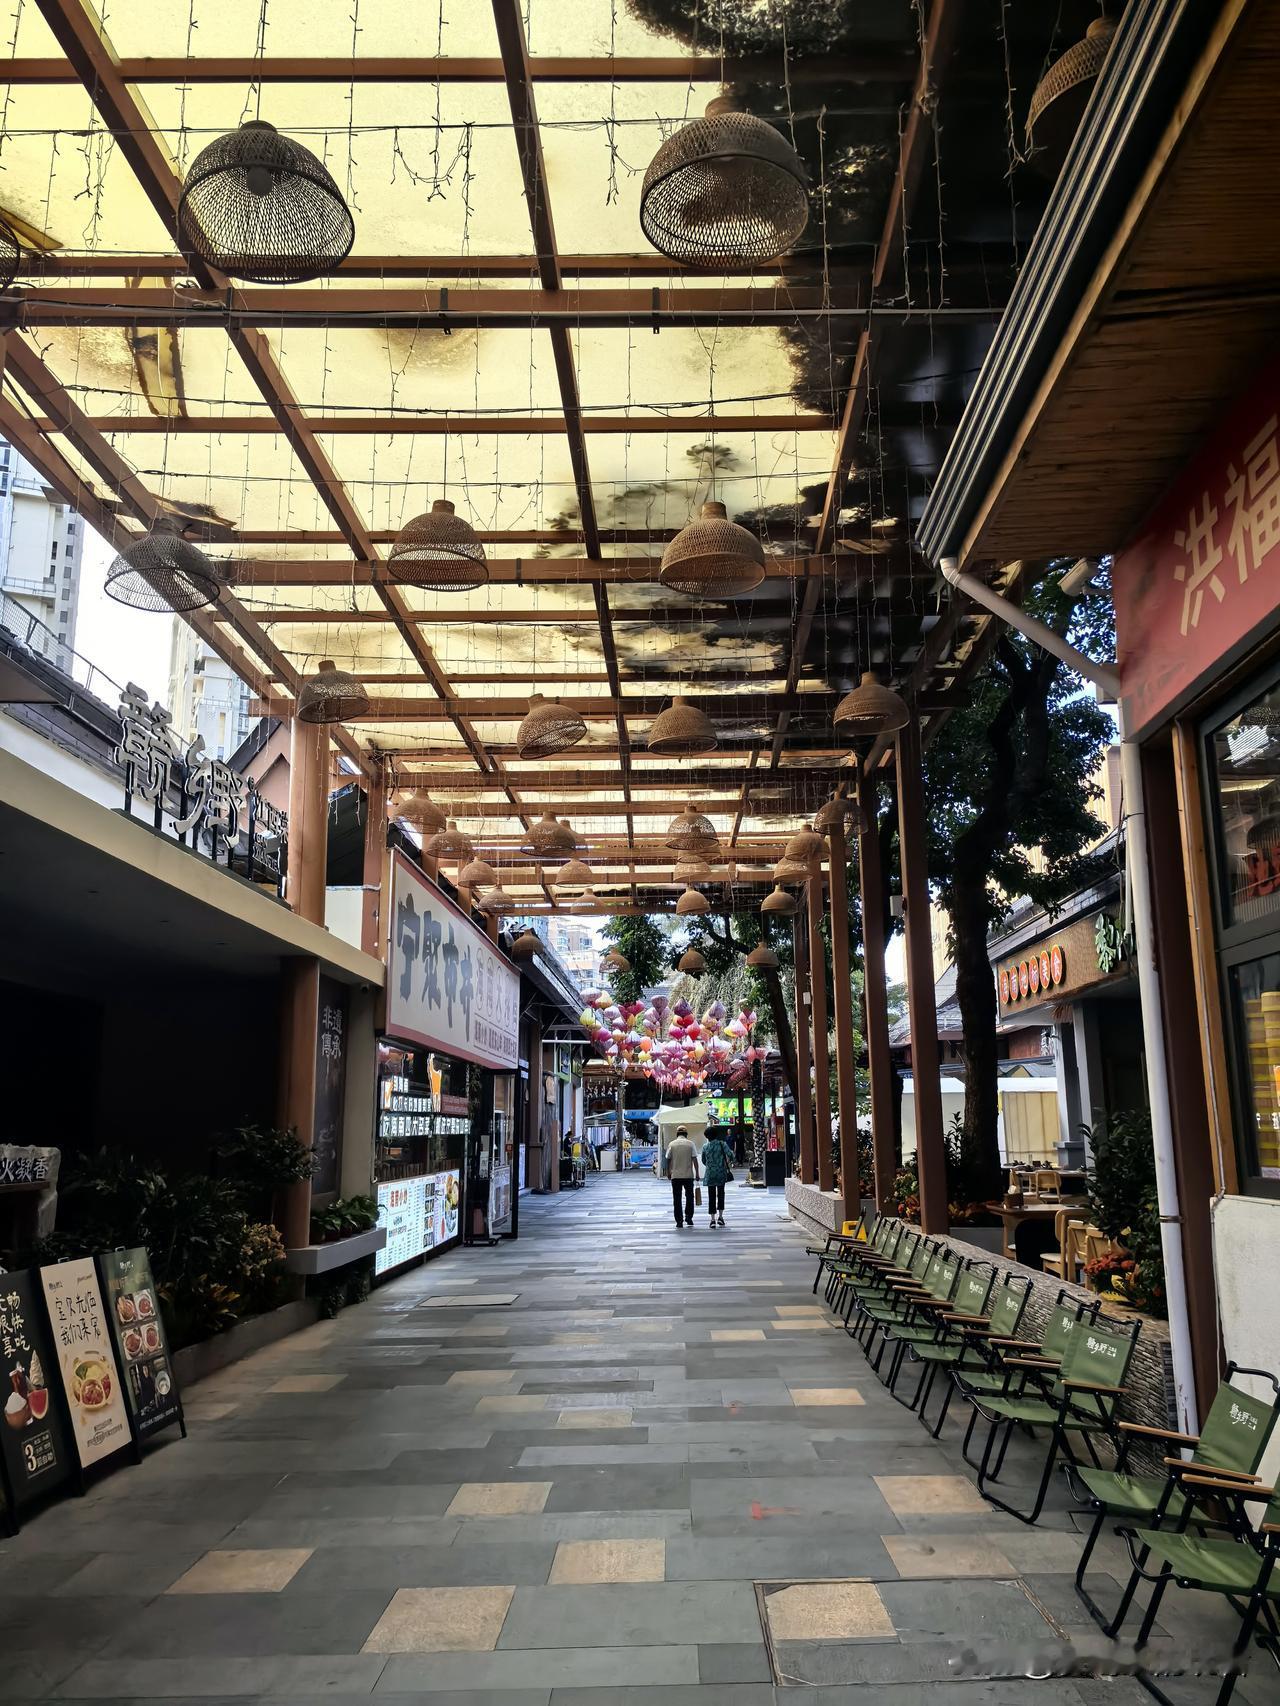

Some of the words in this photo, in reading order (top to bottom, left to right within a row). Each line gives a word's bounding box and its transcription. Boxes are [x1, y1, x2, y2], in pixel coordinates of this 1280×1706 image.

[1173, 414, 1280, 637] 洪福
[475, 947, 518, 1032] 海南大
[25, 1440, 37, 1473] 3
